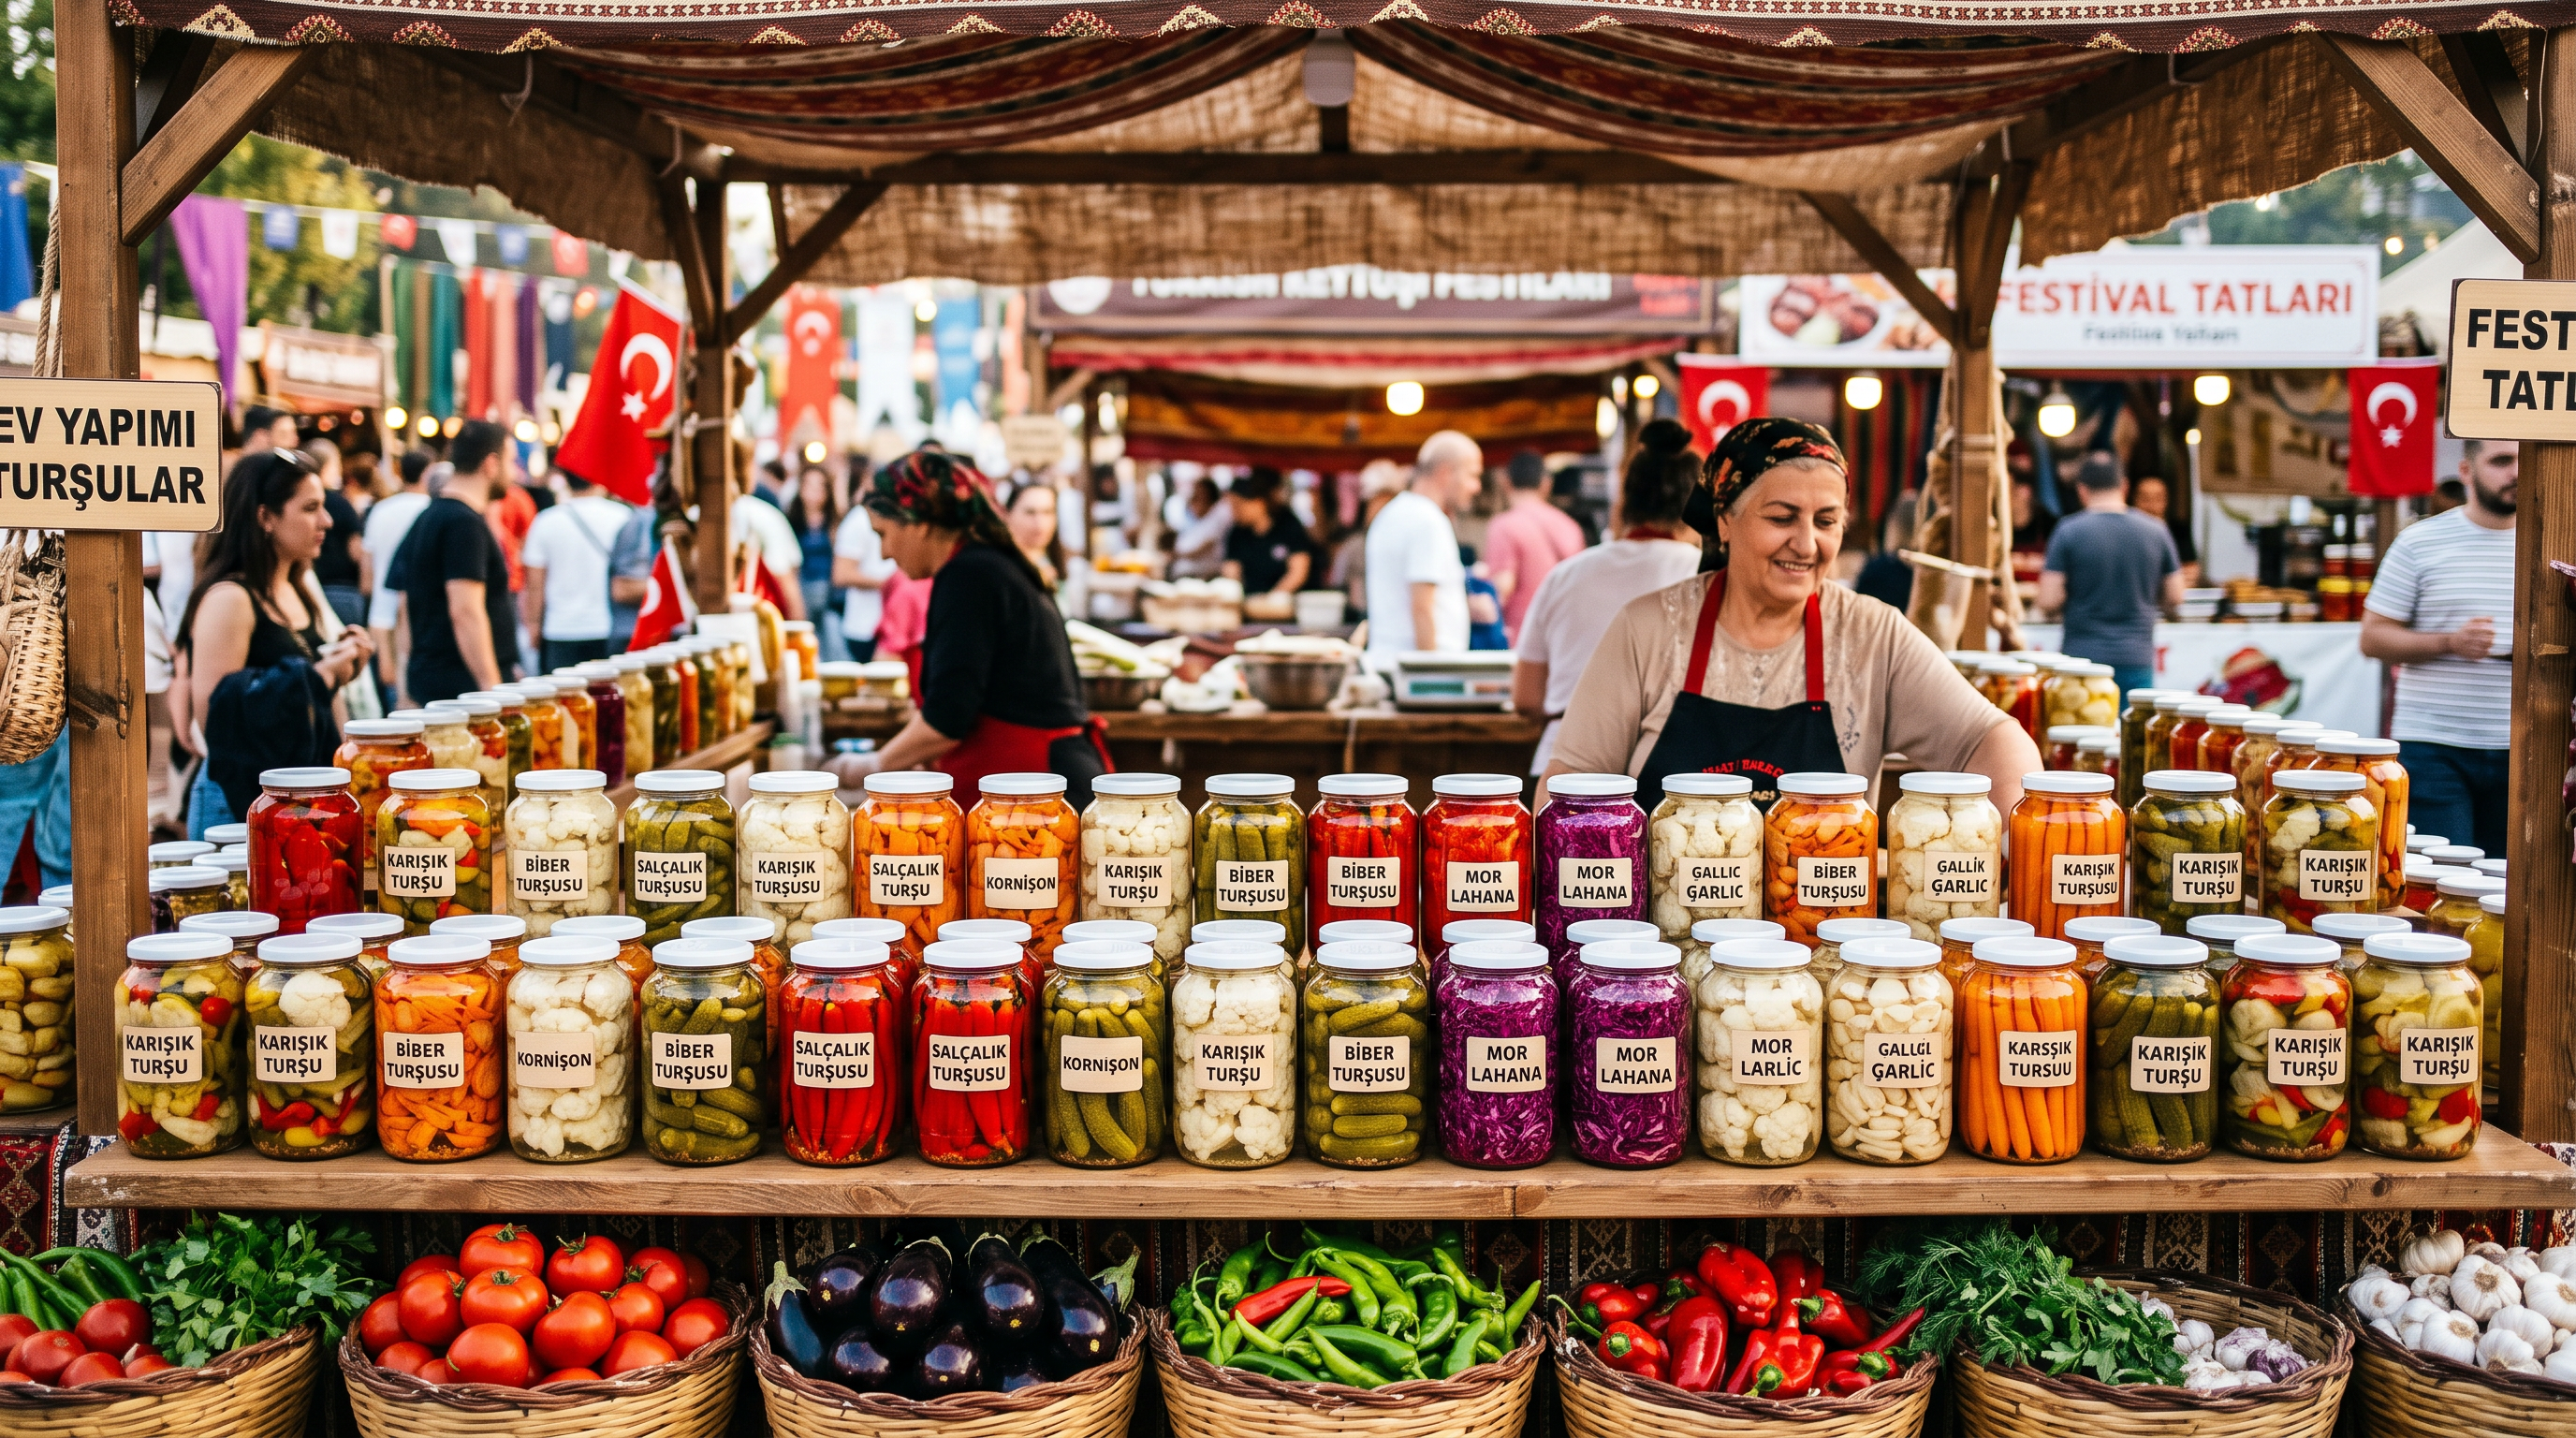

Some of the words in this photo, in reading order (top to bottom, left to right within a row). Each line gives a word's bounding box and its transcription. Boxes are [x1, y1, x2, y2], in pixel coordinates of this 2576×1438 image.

[2192, 282, 2352, 314] TATLARI
[54, 407, 196, 448] YAPIMI
[388, 853, 448, 873] KARIŞIK
[525, 854, 570, 873] BİBER
[637, 859, 703, 878] SALÇALIK
[758, 859, 816, 878] KARIŞIK
[872, 862, 940, 881] SALÇALIK
[1341, 861, 1386, 879] BİBER
[1576, 865, 1615, 880] MOR
[1813, 861, 1857, 879] BİBER
[2063, 862, 2115, 880] KARIŞIK
[2179, 859, 2239, 879] KARIŞIK
[2305, 857, 2367, 877] KARIŞIK
[390, 873, 443, 894] TURŞU
[987, 873, 1056, 894] KORNİŞON
[1105, 864, 1163, 883] KARIŞIK
[1229, 865, 1275, 884] BİBER
[1465, 870, 1502, 884] MOR
[516, 877, 583, 897] TURŞUSU
[637, 878, 703, 898] TURŞUSU
[754, 879, 820, 898] TURŞUSU
[881, 883, 930, 901] TURŞU
[1108, 885, 1158, 903] TURŞU
[1330, 884, 1397, 902] TURŞUSU
[1451, 888, 1515, 904] LAHANA
[1563, 885, 1628, 900] LAHANA
[1800, 885, 1866, 903] TURŞUSU
[2057, 881, 2117, 899] TURŞUSU
[2182, 880, 2235, 900] TURŞU
[2310, 878, 2364, 898] TURŞU
[1218, 888, 1285, 907] TURŞUSU
[125, 1034, 195, 1057] KARIŞIK
[259, 1034, 329, 1056] KARIŞIK
[396, 1038, 446, 1058] BİBER
[666, 1038, 714, 1059] BİBER
[796, 1039, 871, 1062] SALÇALIK
[931, 1043, 1007, 1064] SALÇALIK
[1202, 1044, 1266, 1064] KARIŞIK
[1345, 1041, 1395, 1061] BİBER
[1486, 1045, 1528, 1062] MOR
[1616, 1047, 1658, 1063] MOR
[1751, 1038, 1793, 1054] MOR
[2407, 1034, 2475, 1058] KARIŞIK
[130, 1057, 188, 1079] TURŞU
[263, 1057, 322, 1078] TURŞU
[517, 1050, 592, 1072] KORNİŞON
[1063, 1055, 1139, 1076] KORNİŞON
[2279, 1060, 2338, 1081] TURŞU
[2412, 1058, 2470, 1079] TURŞU
[386, 1062, 460, 1084] TURŞUSU
[654, 1063, 728, 1085] TURŞUSU
[796, 1061, 869, 1083] TURŞUSU
[932, 1065, 1006, 1087] TURŞUSU
[1206, 1066, 1261, 1087] TURŞU
[1332, 1066, 1405, 1088] TURŞUSU
[1471, 1065, 1543, 1083] LAHANA
[1601, 1068, 1673, 1085] LAHANA
[2143, 1067, 2202, 1089] TURŞU
